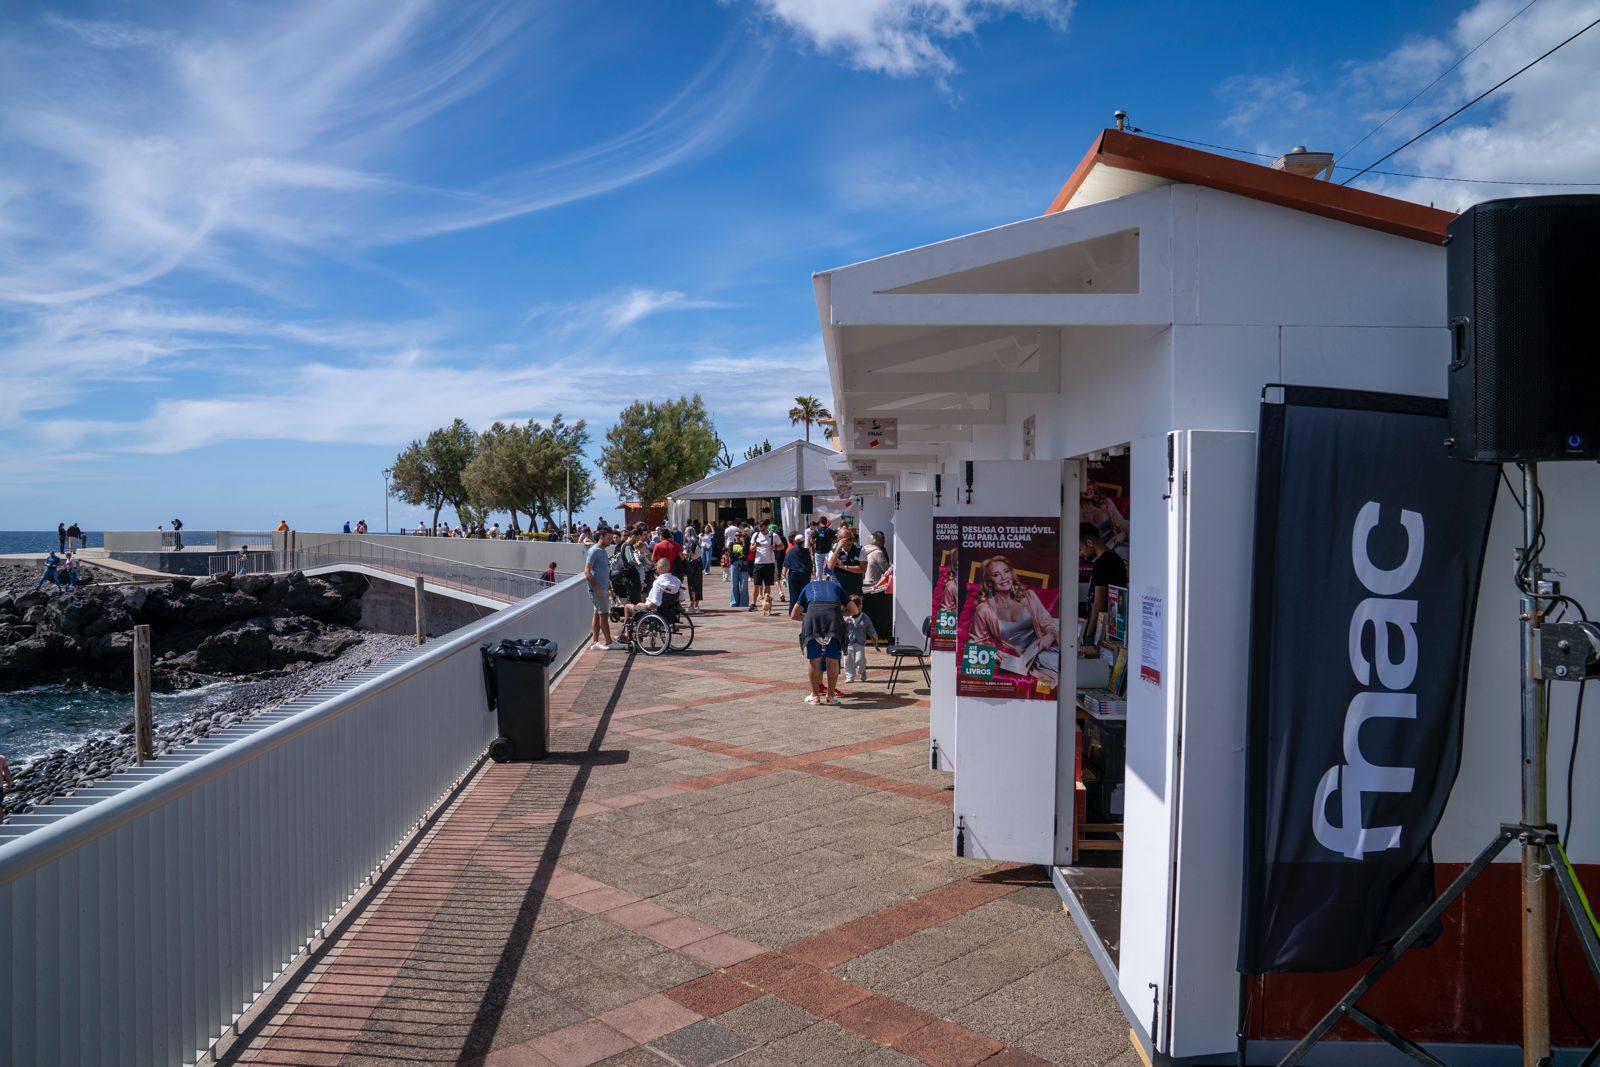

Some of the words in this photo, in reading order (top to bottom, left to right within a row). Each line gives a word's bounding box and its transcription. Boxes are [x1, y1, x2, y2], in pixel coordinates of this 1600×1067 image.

[998, 526, 1004, 534] O
[1006, 525, 1055, 534] TELEMÓVEL.
[963, 650, 997, 664] -50%
[1312, 501, 1425, 860] fnac
